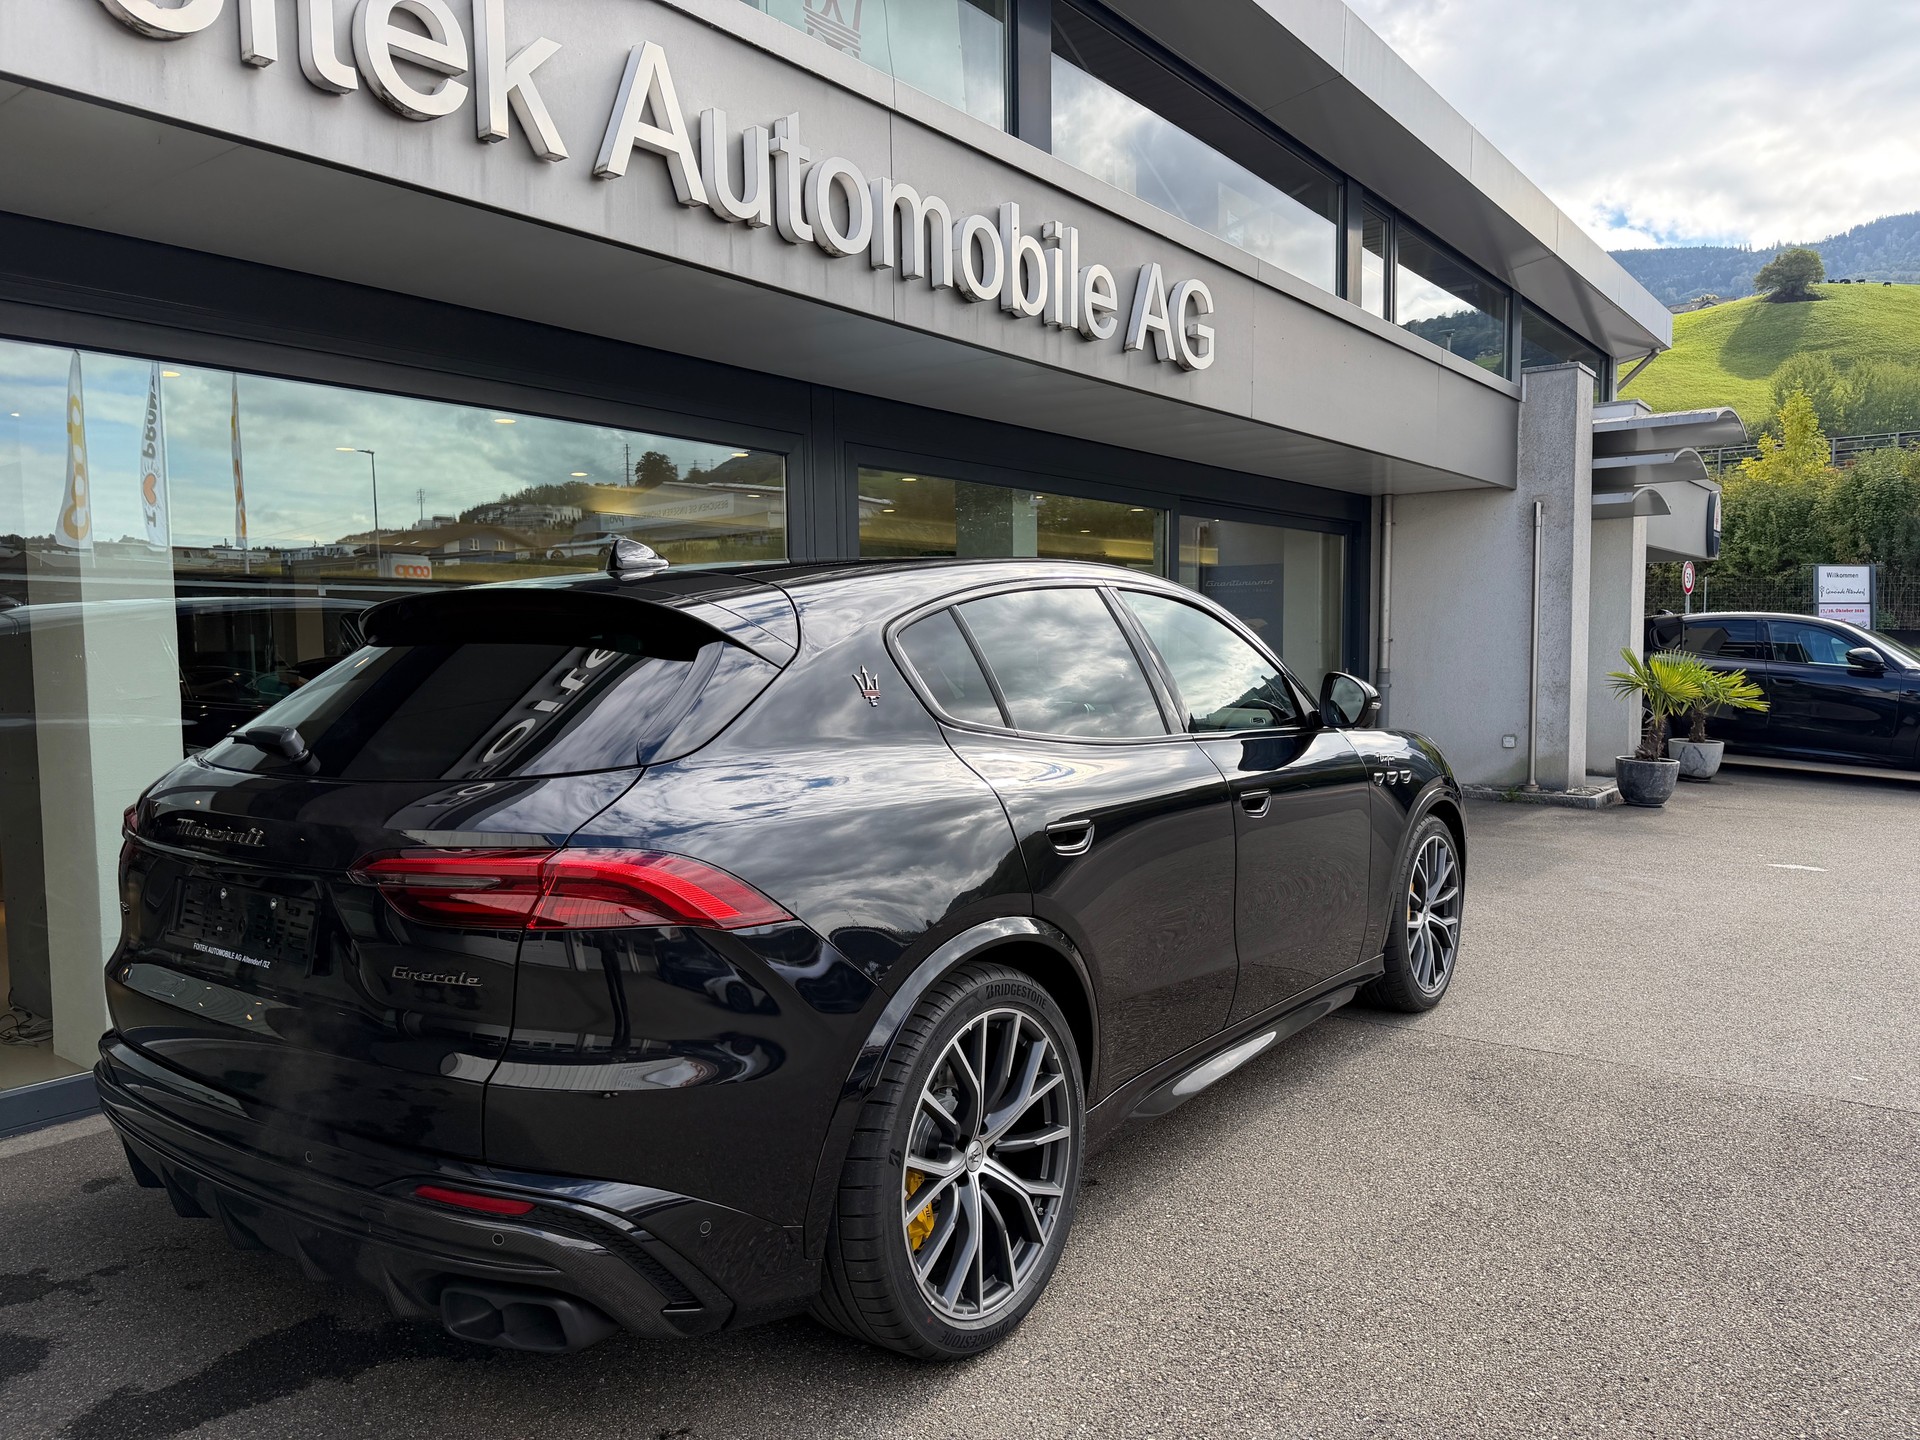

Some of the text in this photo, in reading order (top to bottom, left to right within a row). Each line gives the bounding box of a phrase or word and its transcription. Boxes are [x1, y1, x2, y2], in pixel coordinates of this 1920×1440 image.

[593, 41, 1118, 341] Automobile
[1124, 263, 1215, 371] AG
[1686, 572, 1692, 583] 50
[177, 818, 265, 847] Maserati
[193, 942, 209, 953] FOITEK
[208, 946, 235, 960] AUTOMOBILE
[235, 953, 243, 962] AG
[242, 956, 262, 966] Altendorf
[392, 966, 483, 986] Grecale
[986, 983, 1047, 1010] BRIDGESTONE
